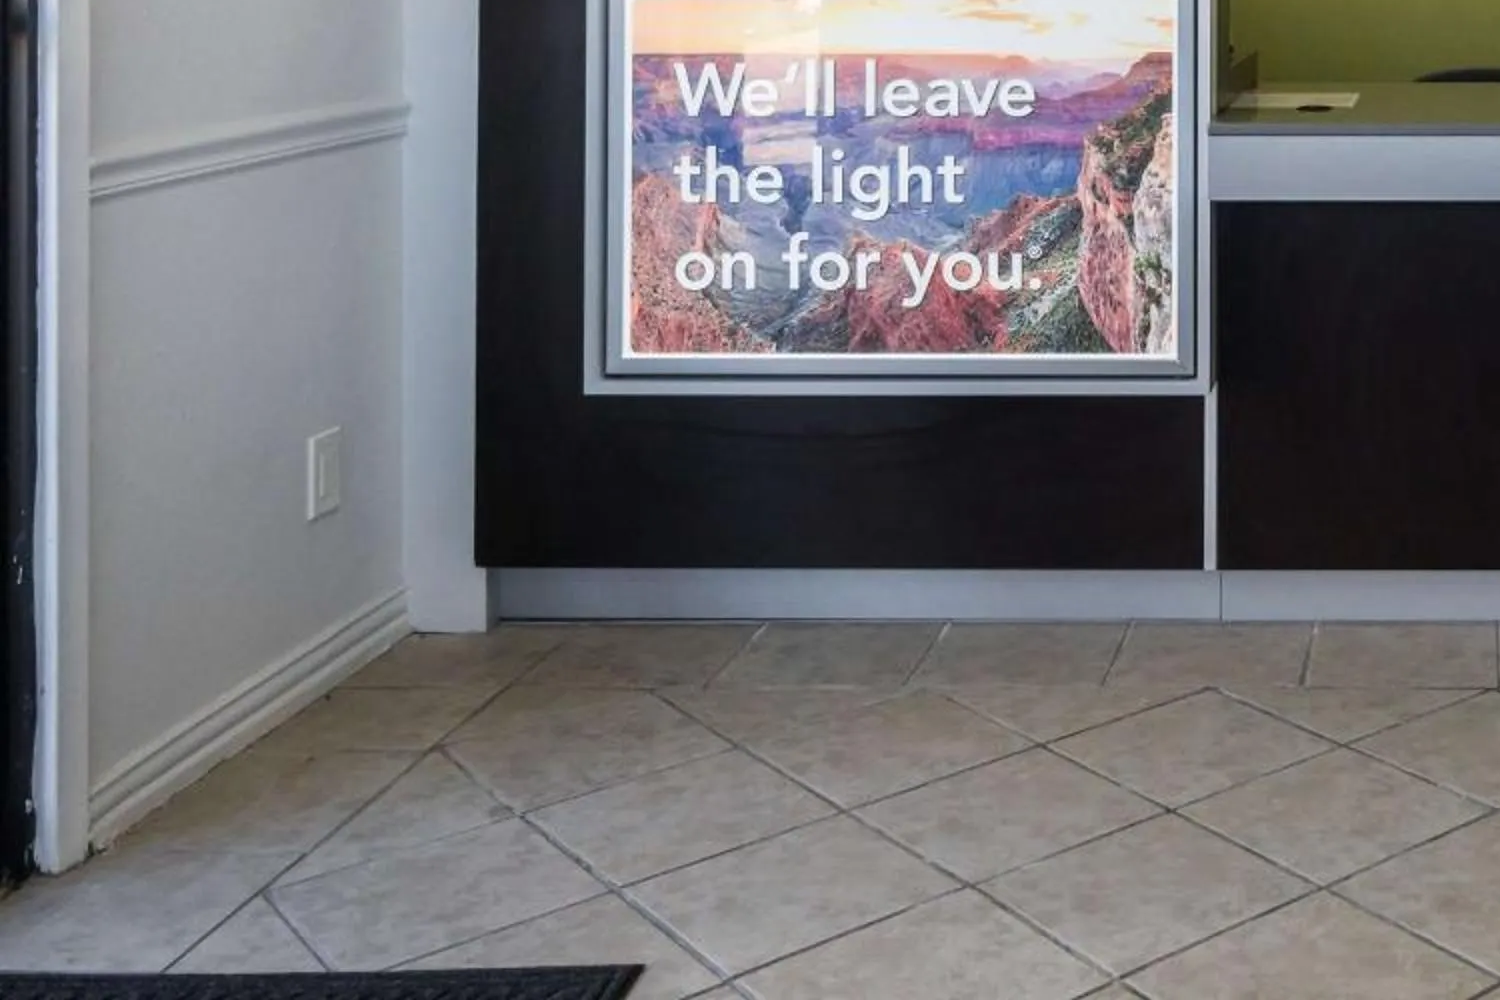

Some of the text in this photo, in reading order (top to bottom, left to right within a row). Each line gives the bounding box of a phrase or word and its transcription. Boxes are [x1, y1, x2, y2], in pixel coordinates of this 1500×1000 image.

[673, 59, 1036, 118] We'll leave
[673, 146, 965, 221] the light
[675, 231, 1042, 309] on for you.
